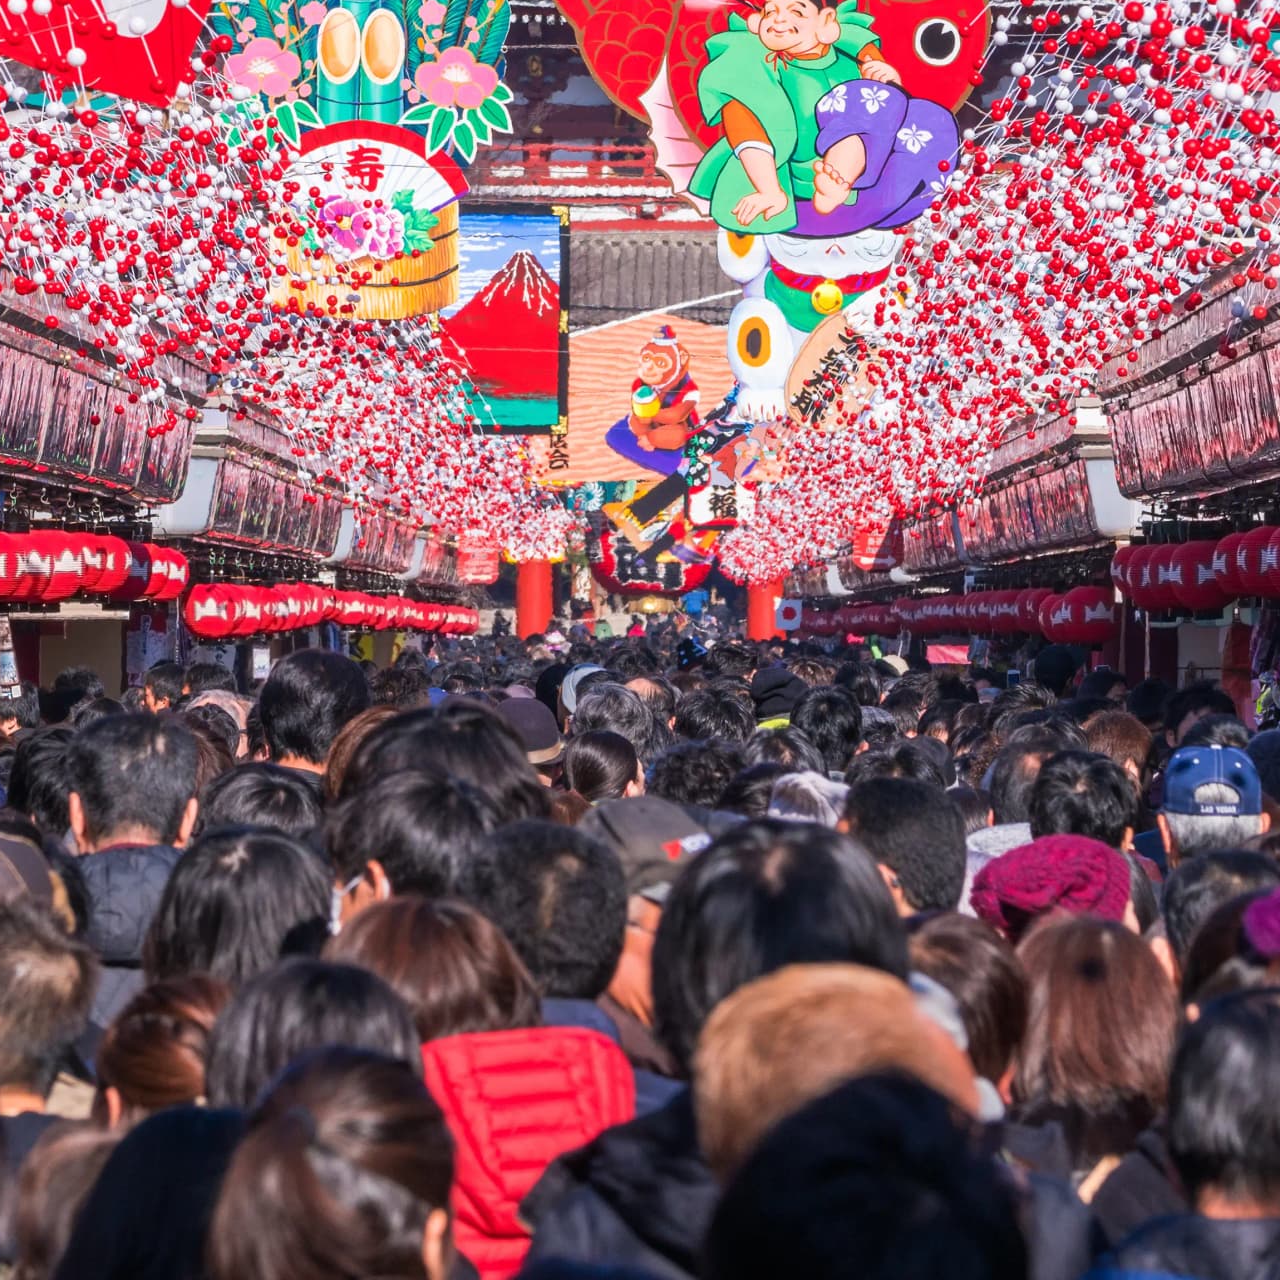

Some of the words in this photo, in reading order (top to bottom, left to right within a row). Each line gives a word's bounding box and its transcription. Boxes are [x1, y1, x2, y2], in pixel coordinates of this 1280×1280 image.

[342, 144, 385, 192] 寿
[1200, 804, 1214, 813] LAS
[1215, 804, 1237, 814] VEGAS
